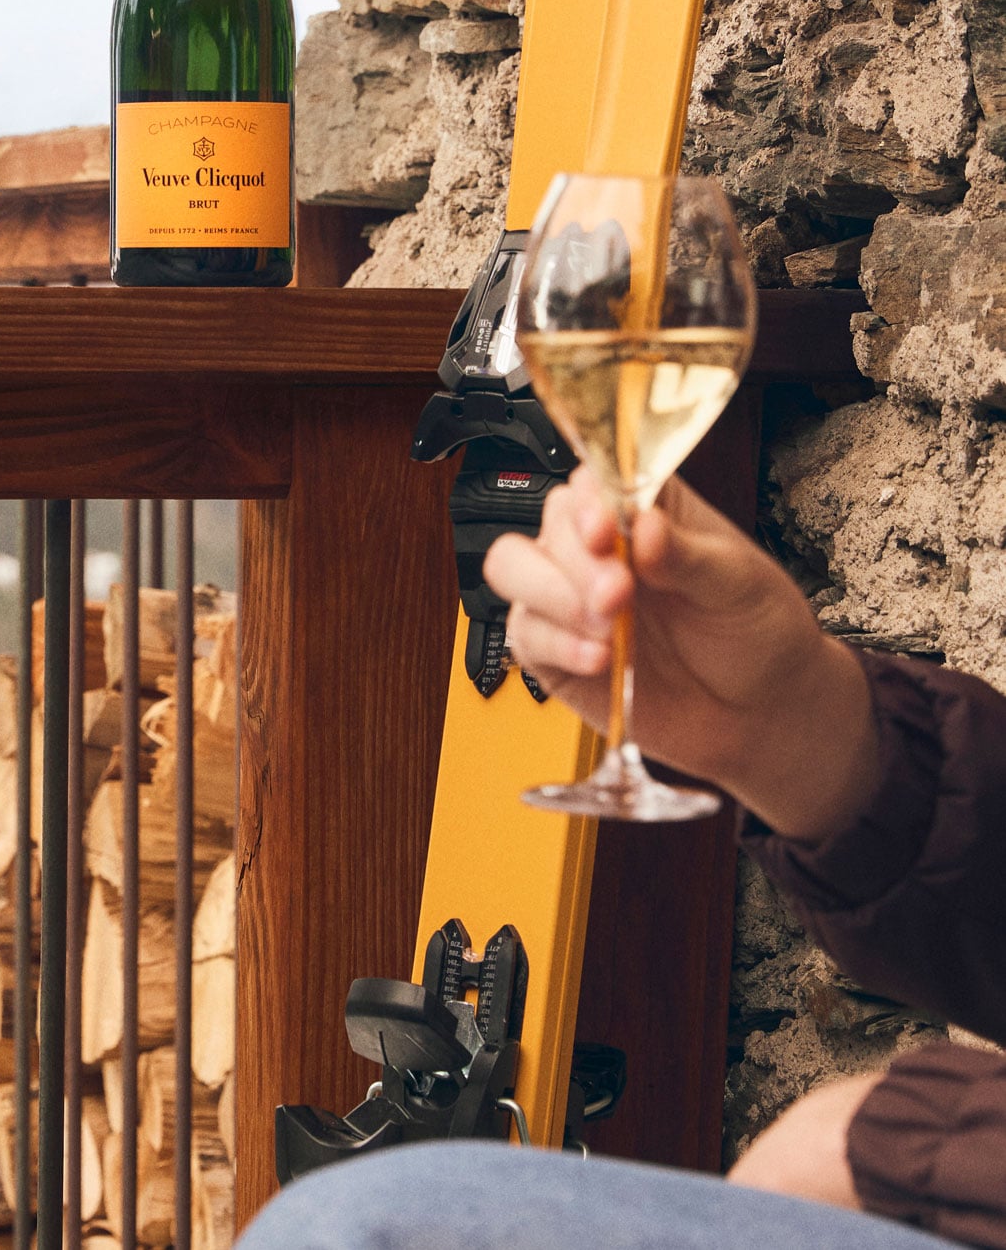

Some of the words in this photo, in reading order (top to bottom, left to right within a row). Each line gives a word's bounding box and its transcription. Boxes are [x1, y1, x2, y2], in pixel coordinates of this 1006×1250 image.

[148, 115, 259, 135] CHAMPAGNE
[142, 167, 190, 187] Veuve
[195, 167, 266, 191] Clicquot
[188, 200, 220, 209] BRUT
[498, 480, 529, 488] WALK
